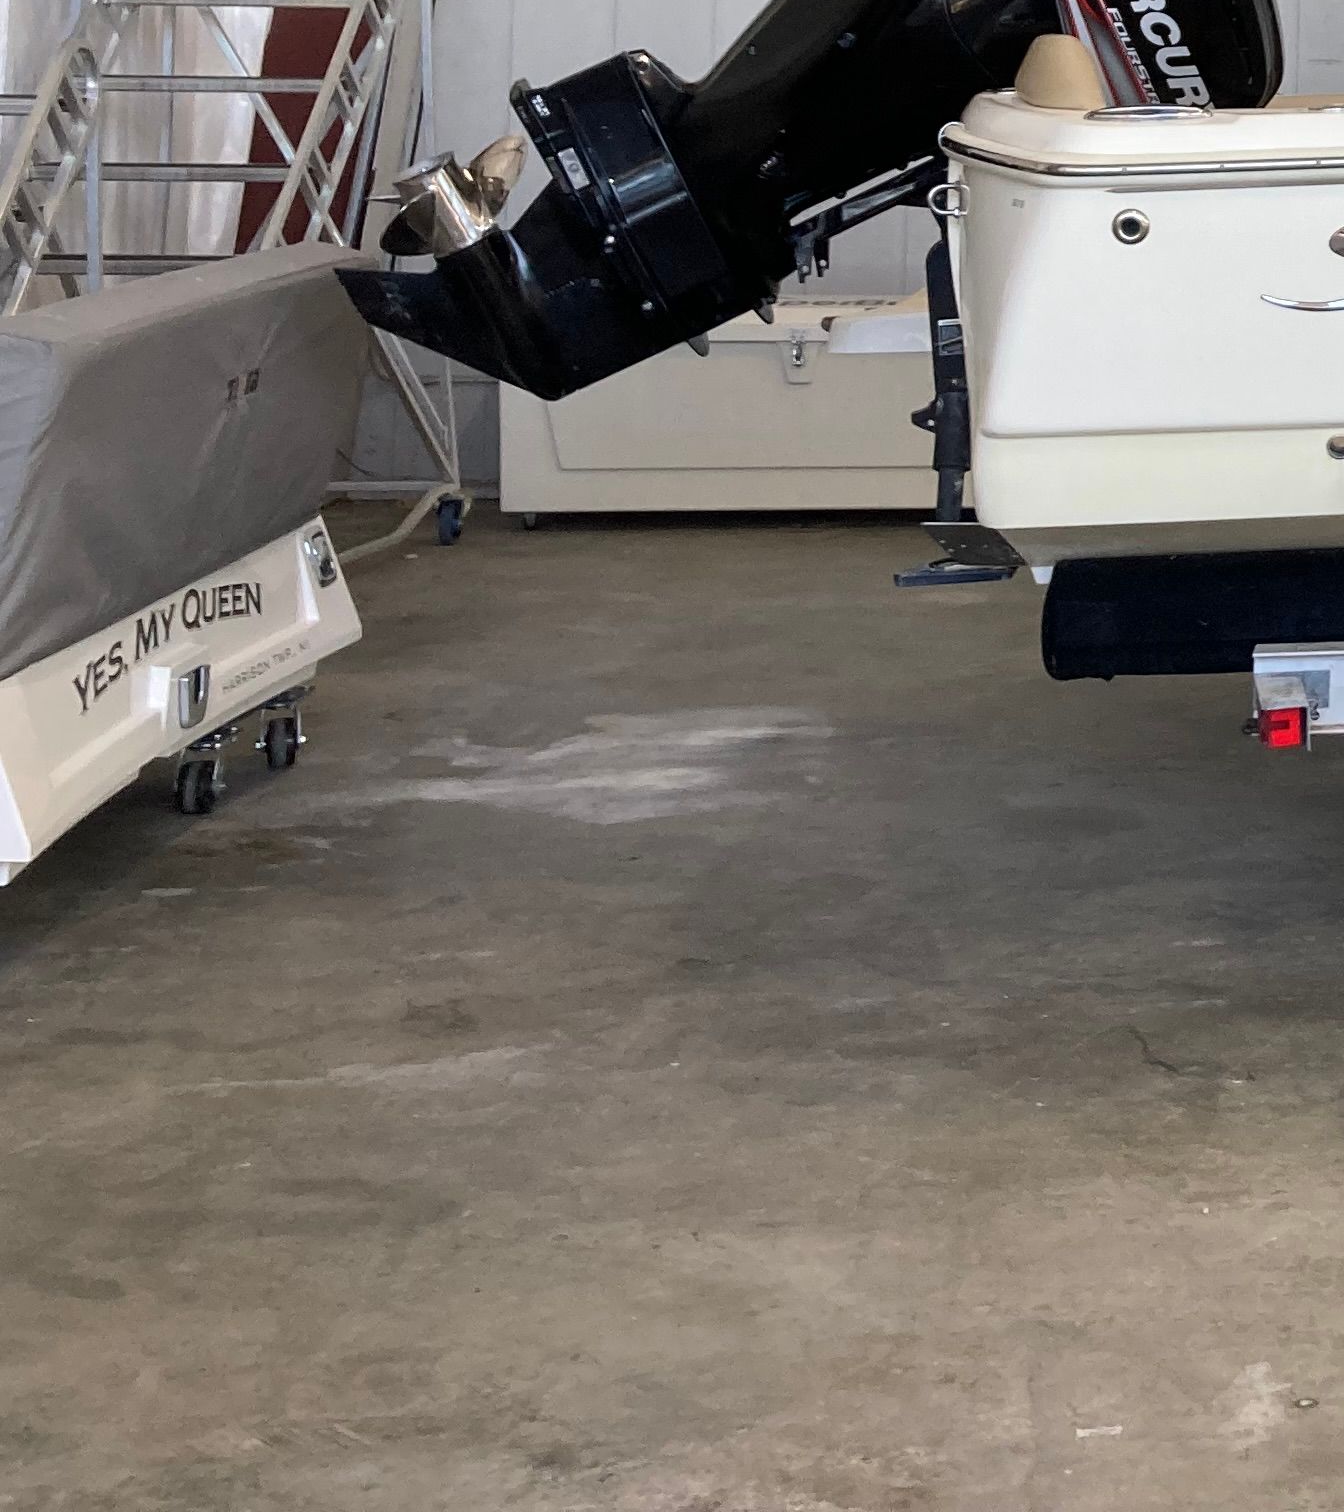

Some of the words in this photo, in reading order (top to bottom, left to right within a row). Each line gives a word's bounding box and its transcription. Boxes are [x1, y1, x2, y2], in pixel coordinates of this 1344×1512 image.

[71, 640, 129, 716] YES,
[134, 603, 176, 663] MY
[181, 582, 262, 629] QUEEN
